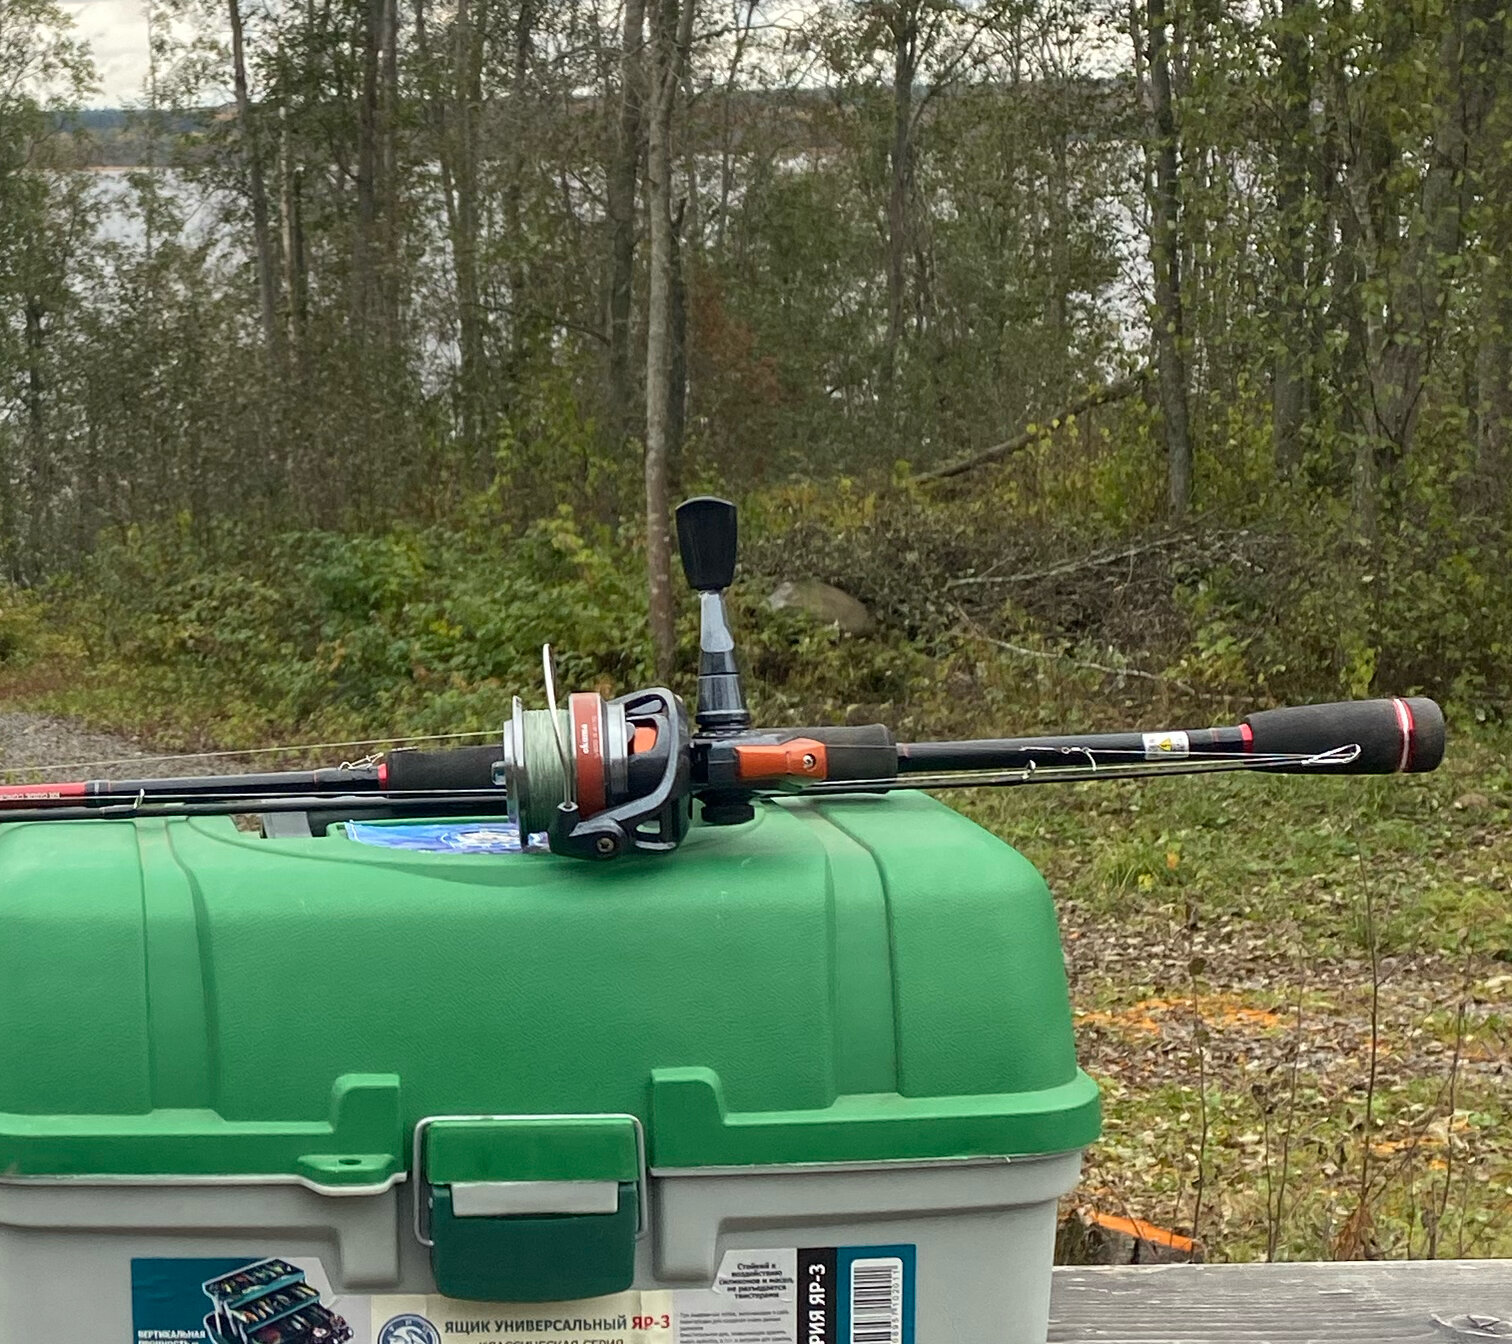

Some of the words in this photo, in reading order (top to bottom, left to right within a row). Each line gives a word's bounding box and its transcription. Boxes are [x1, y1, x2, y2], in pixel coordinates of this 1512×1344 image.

[808, 1263, 826, 1305] ЯР-3
[138, 1330, 206, 1339] ВЕРТИКАЛЬНАЯ
[444, 1319, 490, 1335] ЯЩИК
[494, 1314, 627, 1333] УНИВЕРСАЛЬНЫЙ
[631, 1314, 671, 1331] ЯР-3
